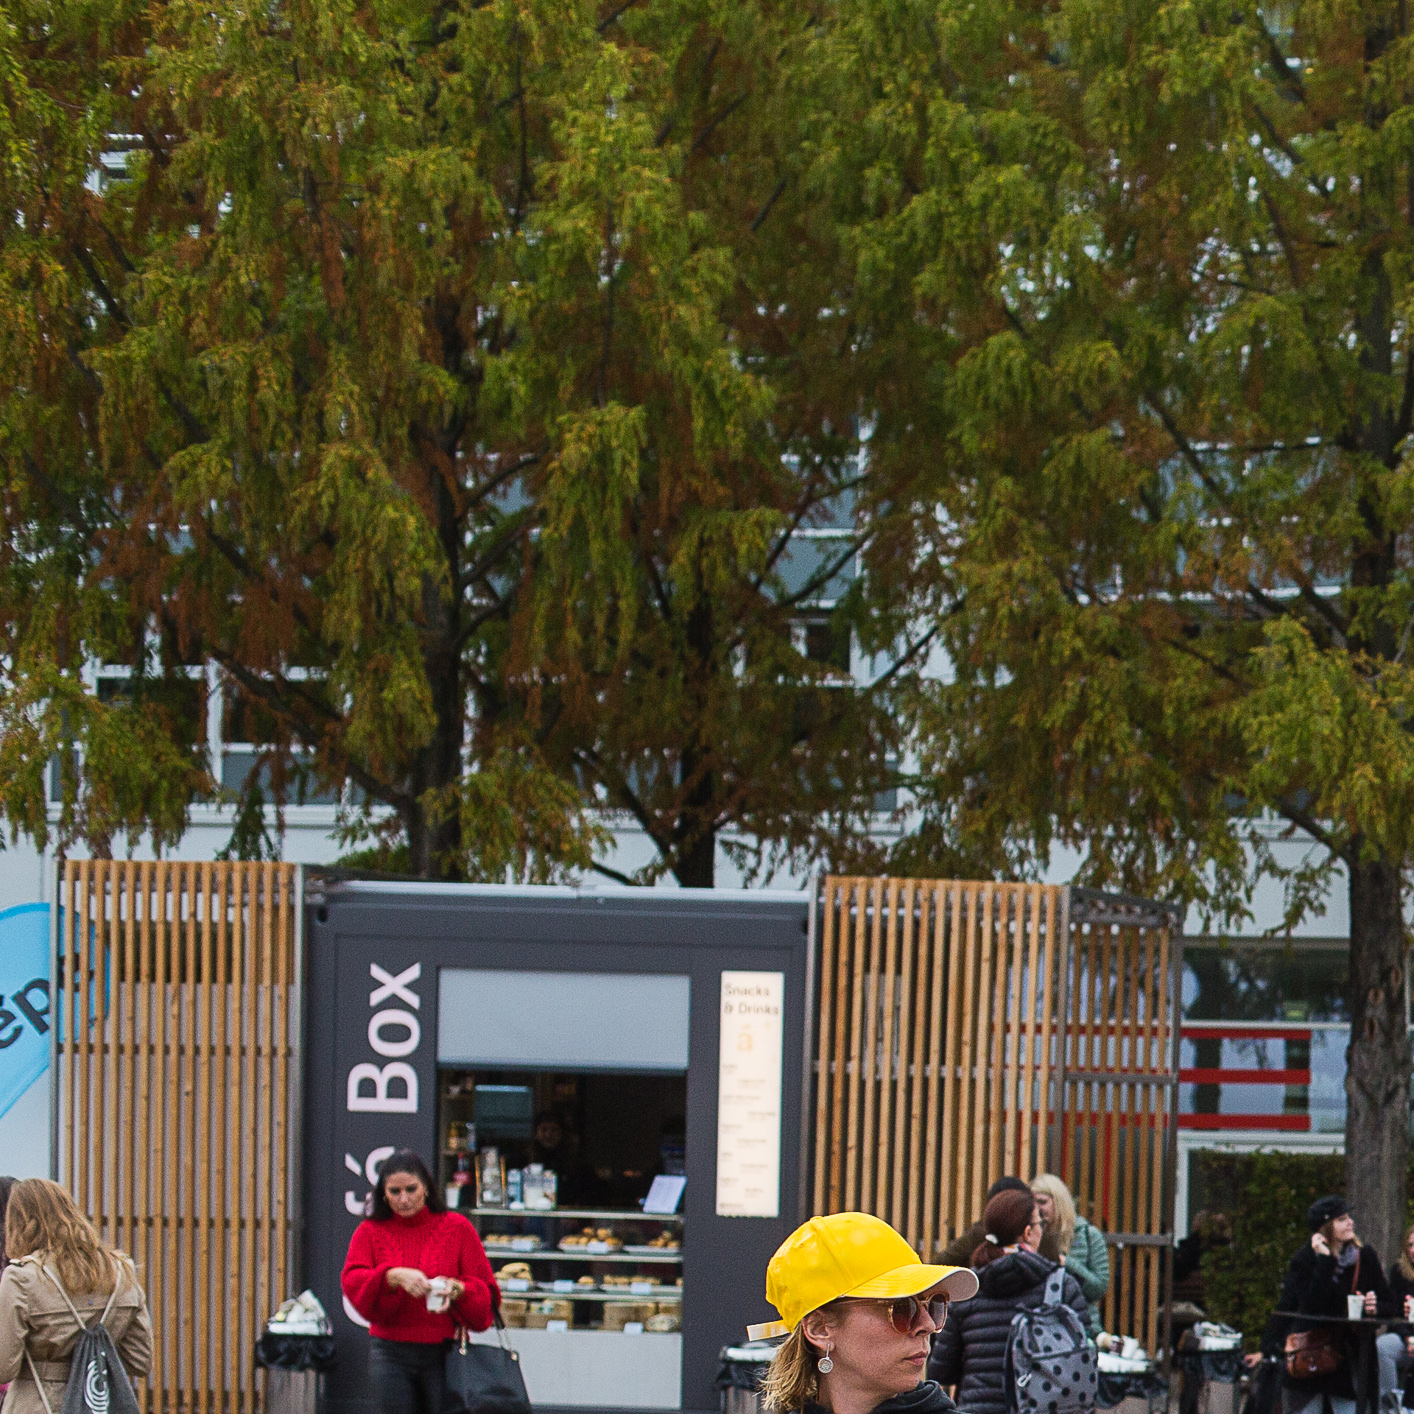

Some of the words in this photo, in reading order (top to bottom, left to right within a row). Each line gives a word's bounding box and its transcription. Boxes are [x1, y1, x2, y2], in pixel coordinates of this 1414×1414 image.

[724, 983, 770, 997] Snacks
[738, 1002, 780, 1016] Drinks
[346, 961, 421, 1113] Box
